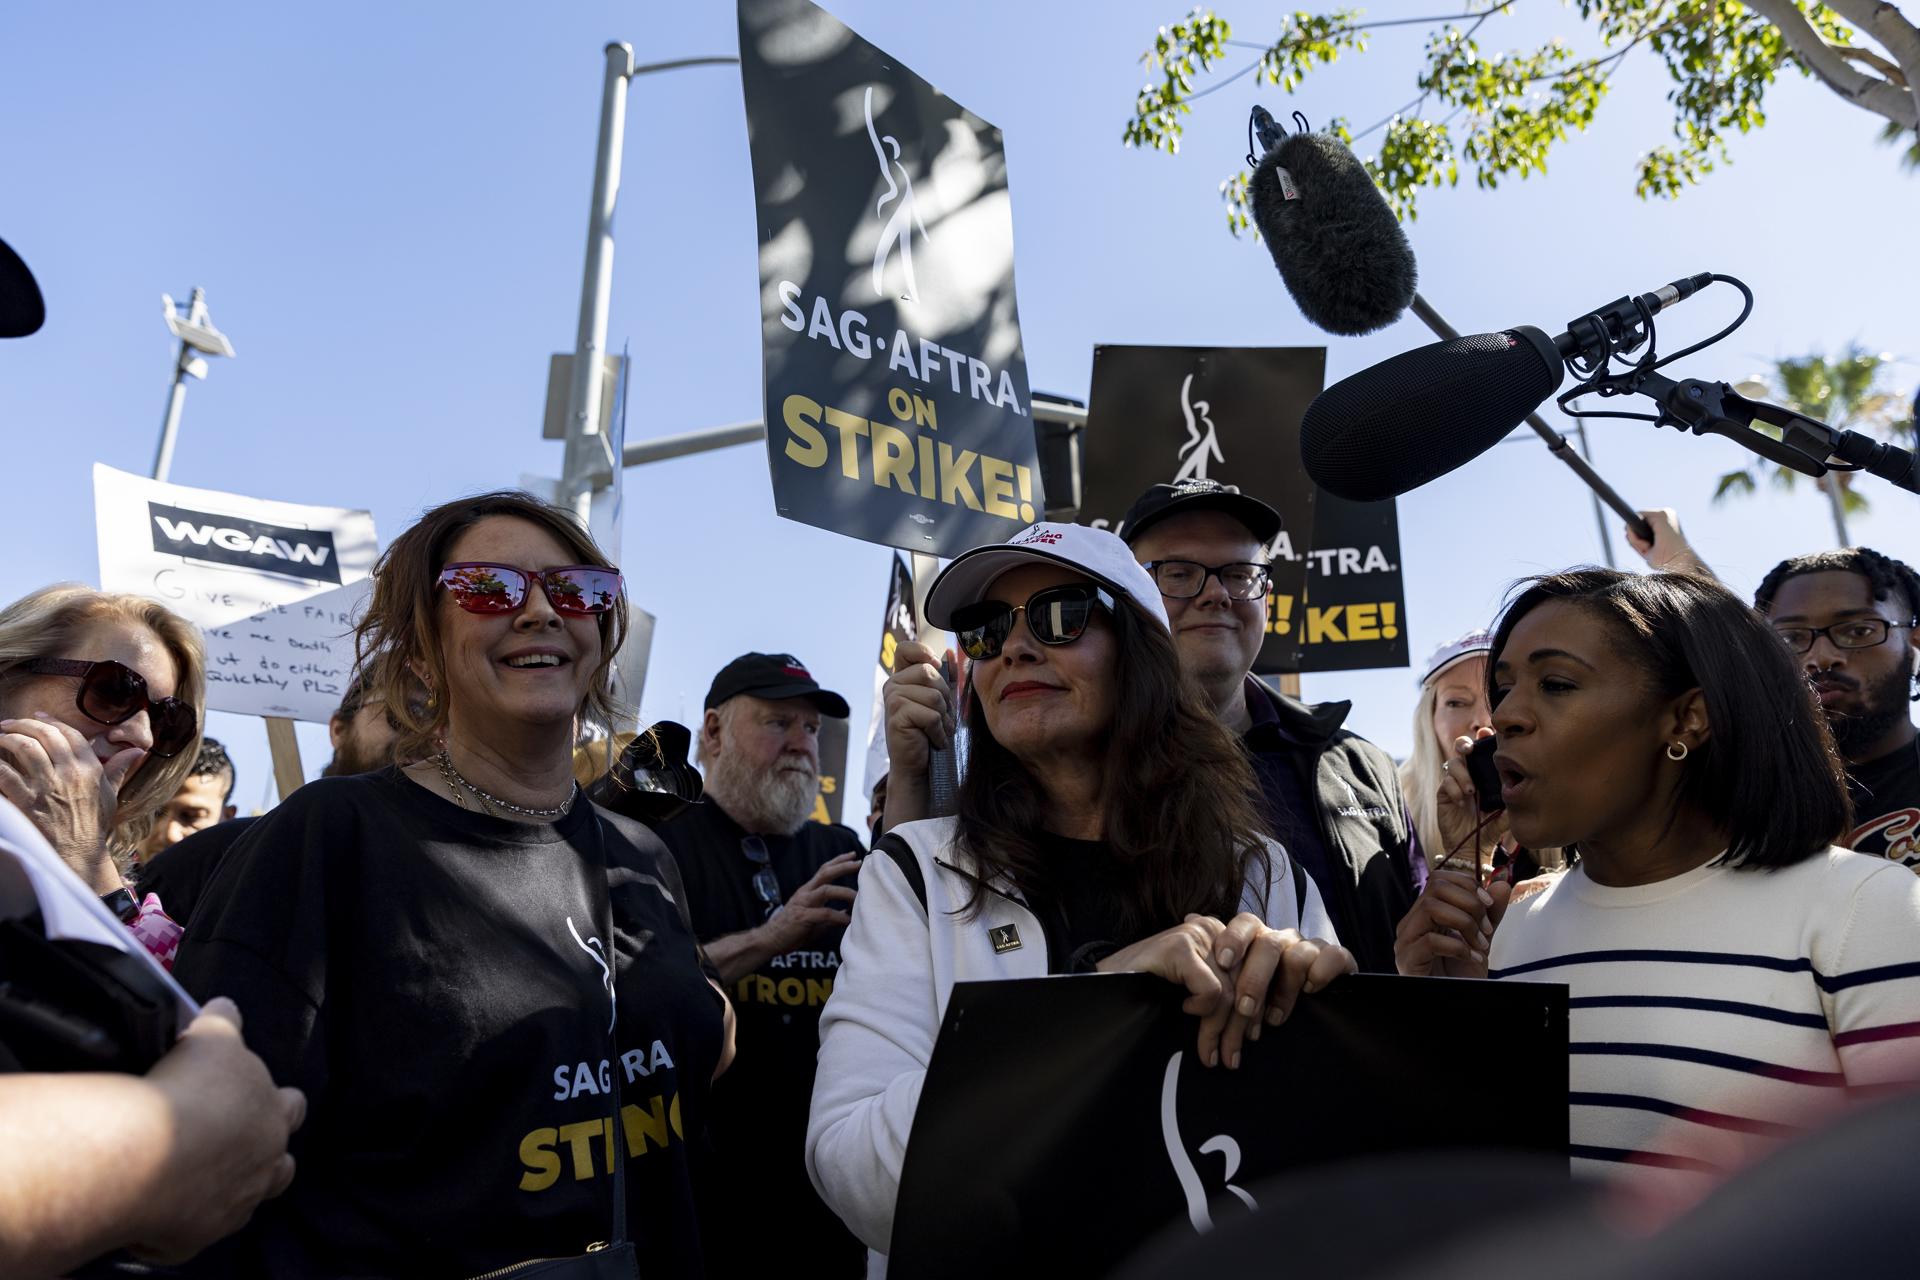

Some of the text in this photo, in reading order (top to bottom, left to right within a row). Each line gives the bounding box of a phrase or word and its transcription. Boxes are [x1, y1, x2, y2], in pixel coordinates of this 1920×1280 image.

[888, 388, 937, 431] ON
[783, 395, 1035, 523] STRIKE!
[154, 516, 329, 567] WGAW
[728, 974, 834, 1006] TRON
